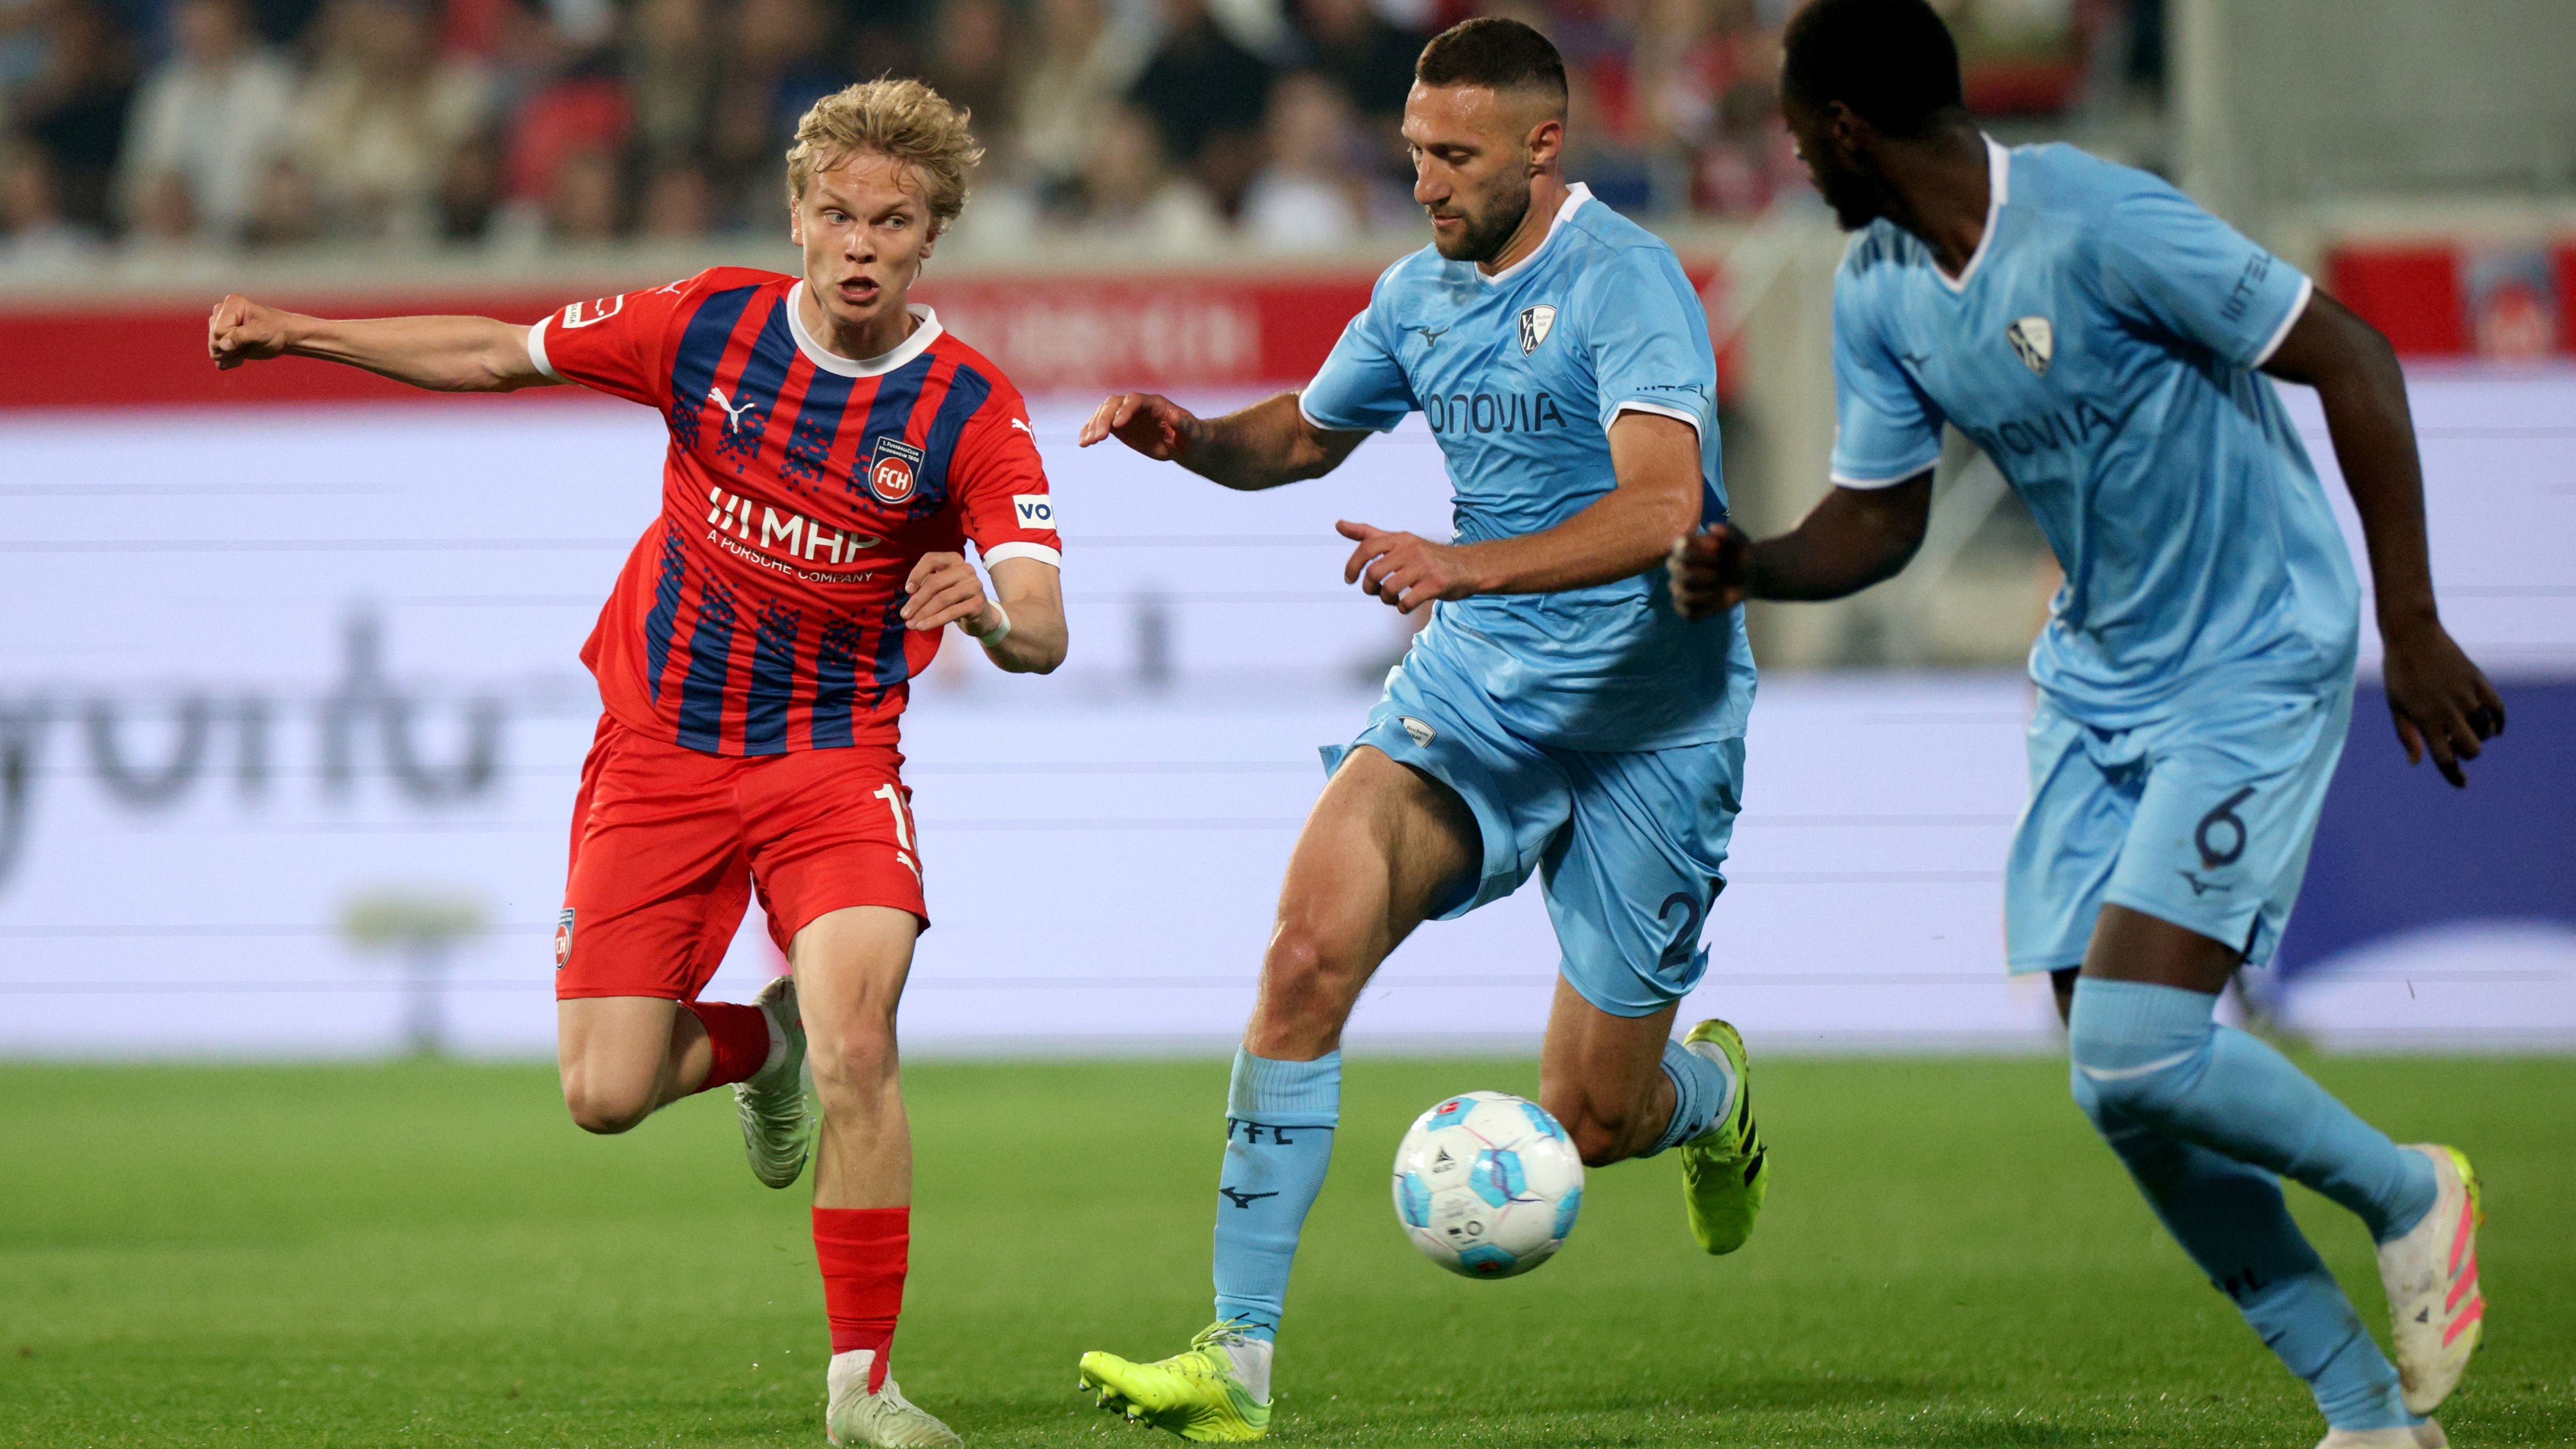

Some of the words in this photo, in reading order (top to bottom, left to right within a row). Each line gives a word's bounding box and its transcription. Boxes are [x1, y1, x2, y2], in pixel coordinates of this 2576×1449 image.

[877, 466, 909, 491] FCH
[707, 530, 717, 543] A
[720, 536, 792, 575] PORSCHE
[798, 569, 873, 583] COMPANY
[759, 506, 882, 564] MHP
[2195, 786, 2257, 866] 6
[1656, 892, 1700, 974] 2
